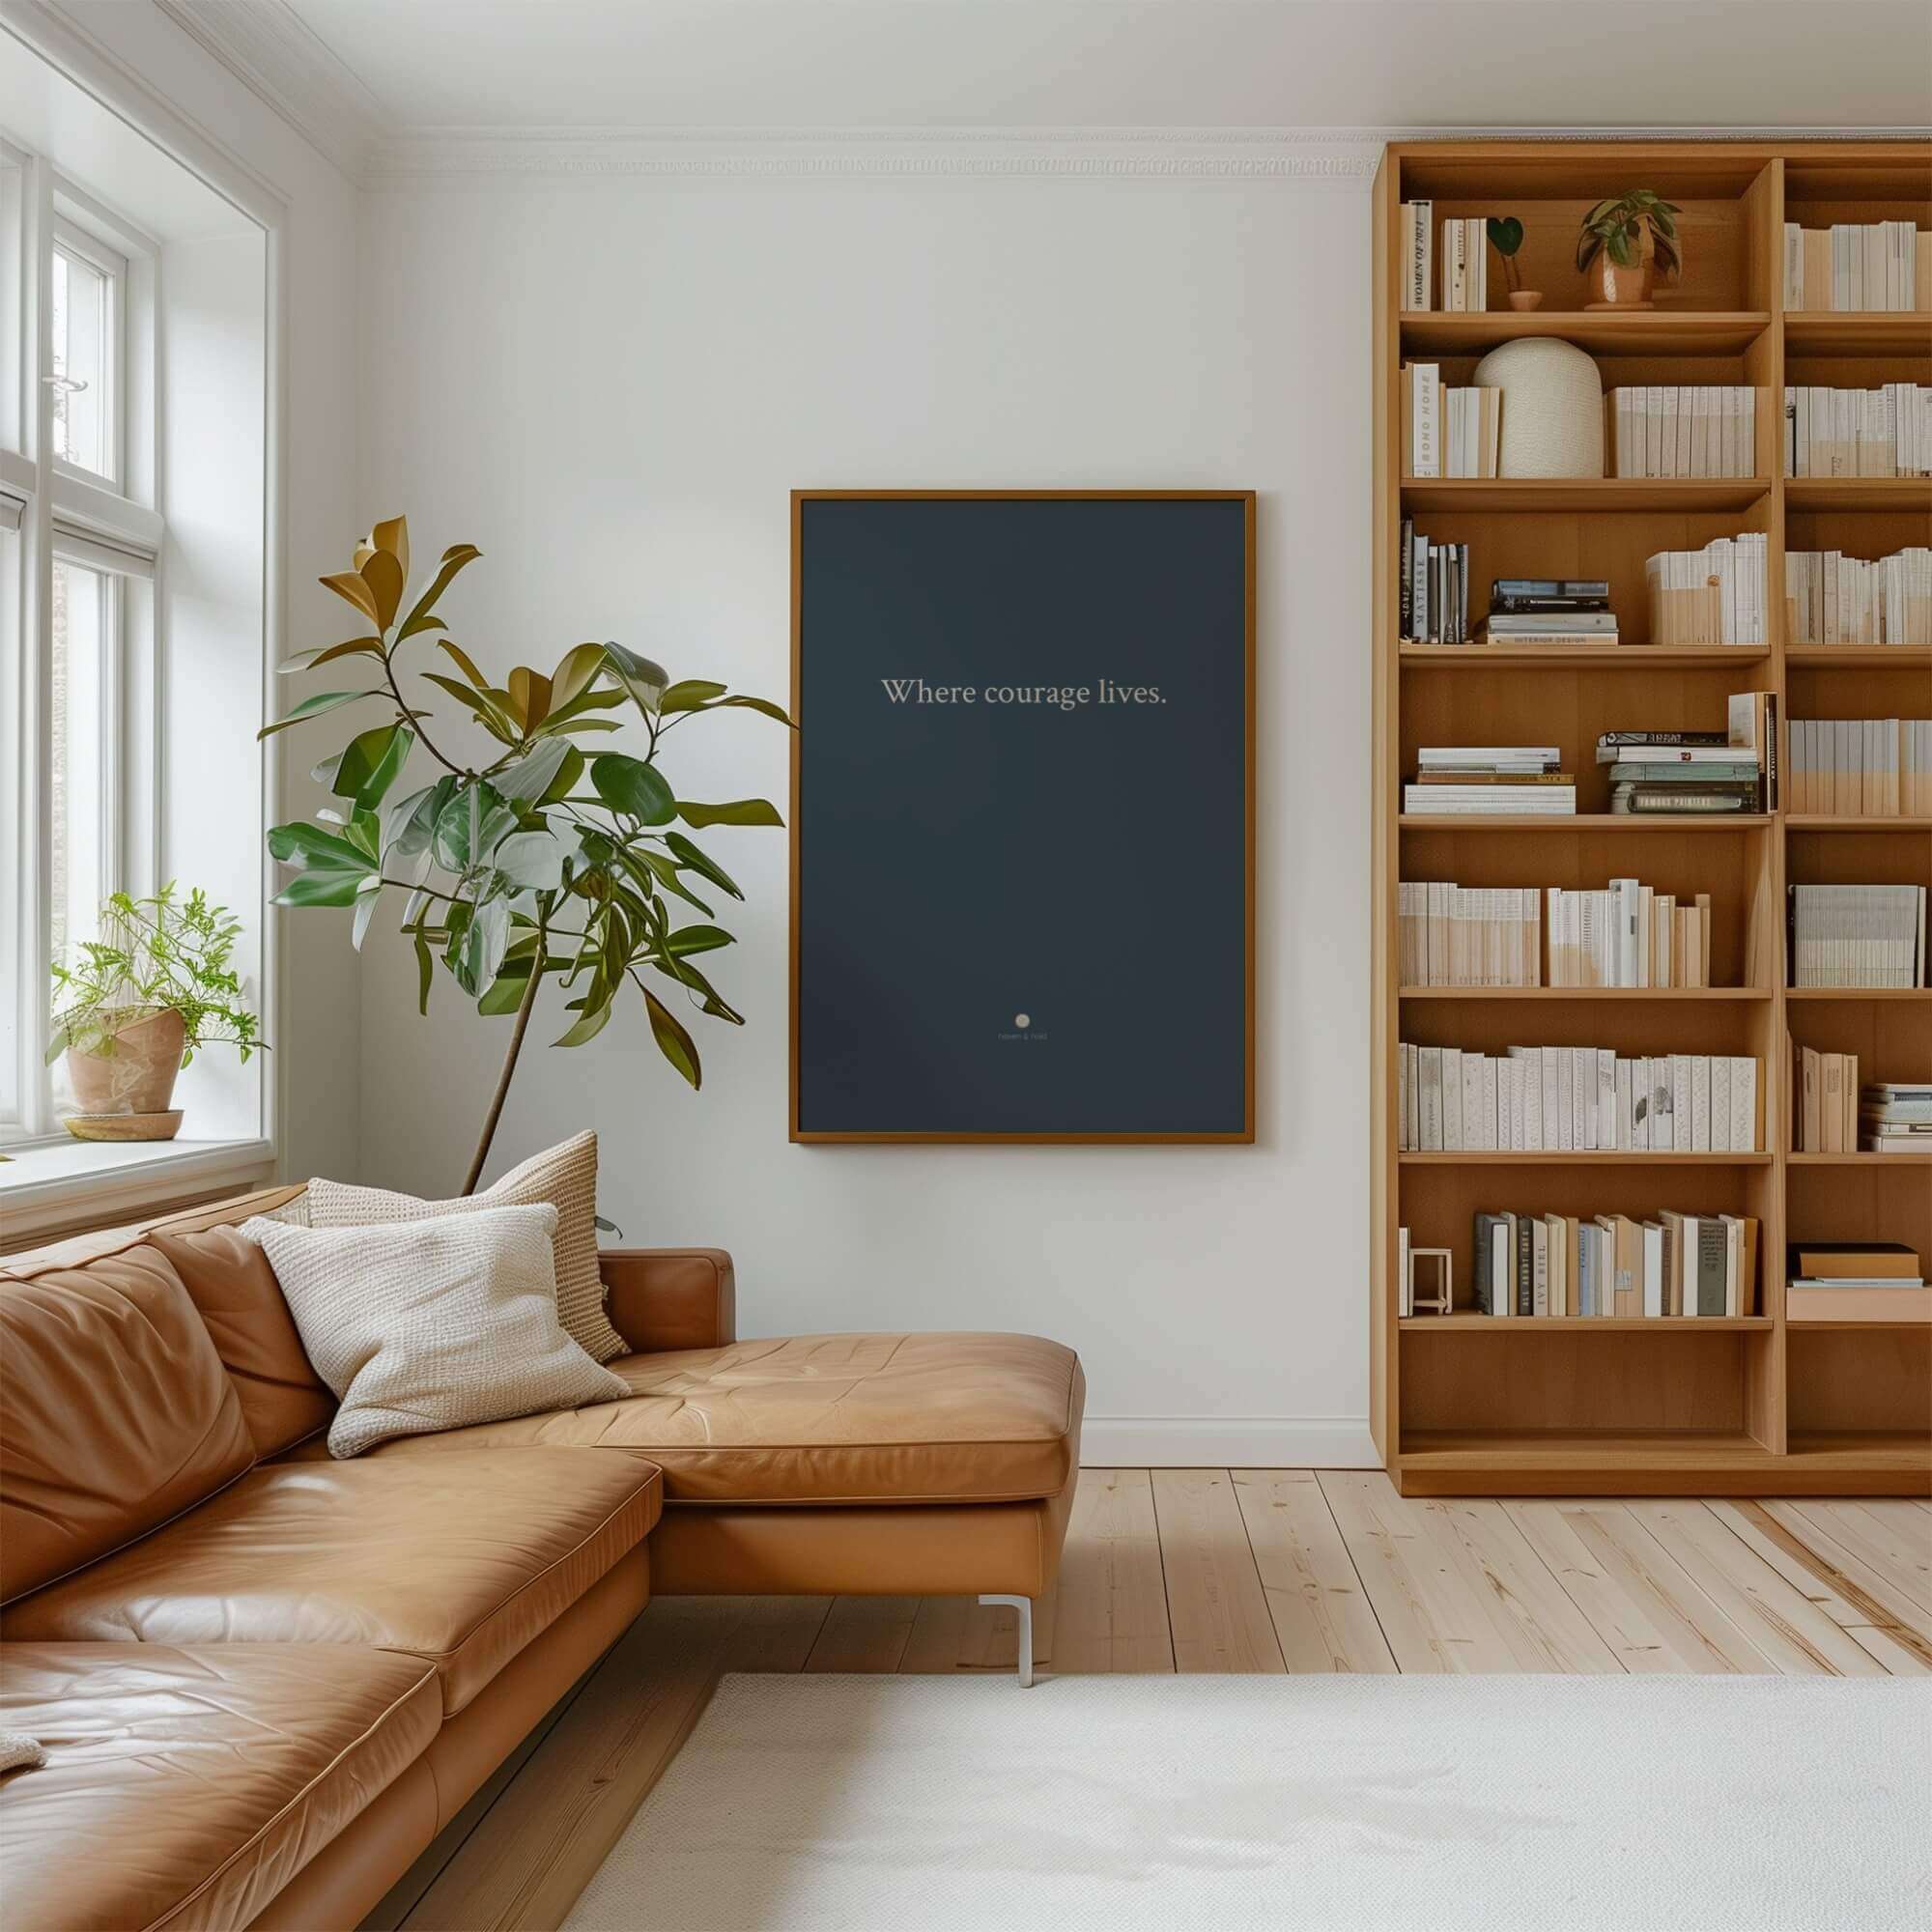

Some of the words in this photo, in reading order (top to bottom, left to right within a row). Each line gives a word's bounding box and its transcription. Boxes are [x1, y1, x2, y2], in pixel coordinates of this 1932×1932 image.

[1414, 246, 1424, 261] OF
[1414, 263, 1423, 305] WOMEN
[1422, 421, 1431, 463] BOHO
[1416, 558, 1425, 625] MATISSE
[881, 678, 977, 705] Where
[983, 685, 1092, 711] courage
[1097, 678, 1168, 705] lives.
